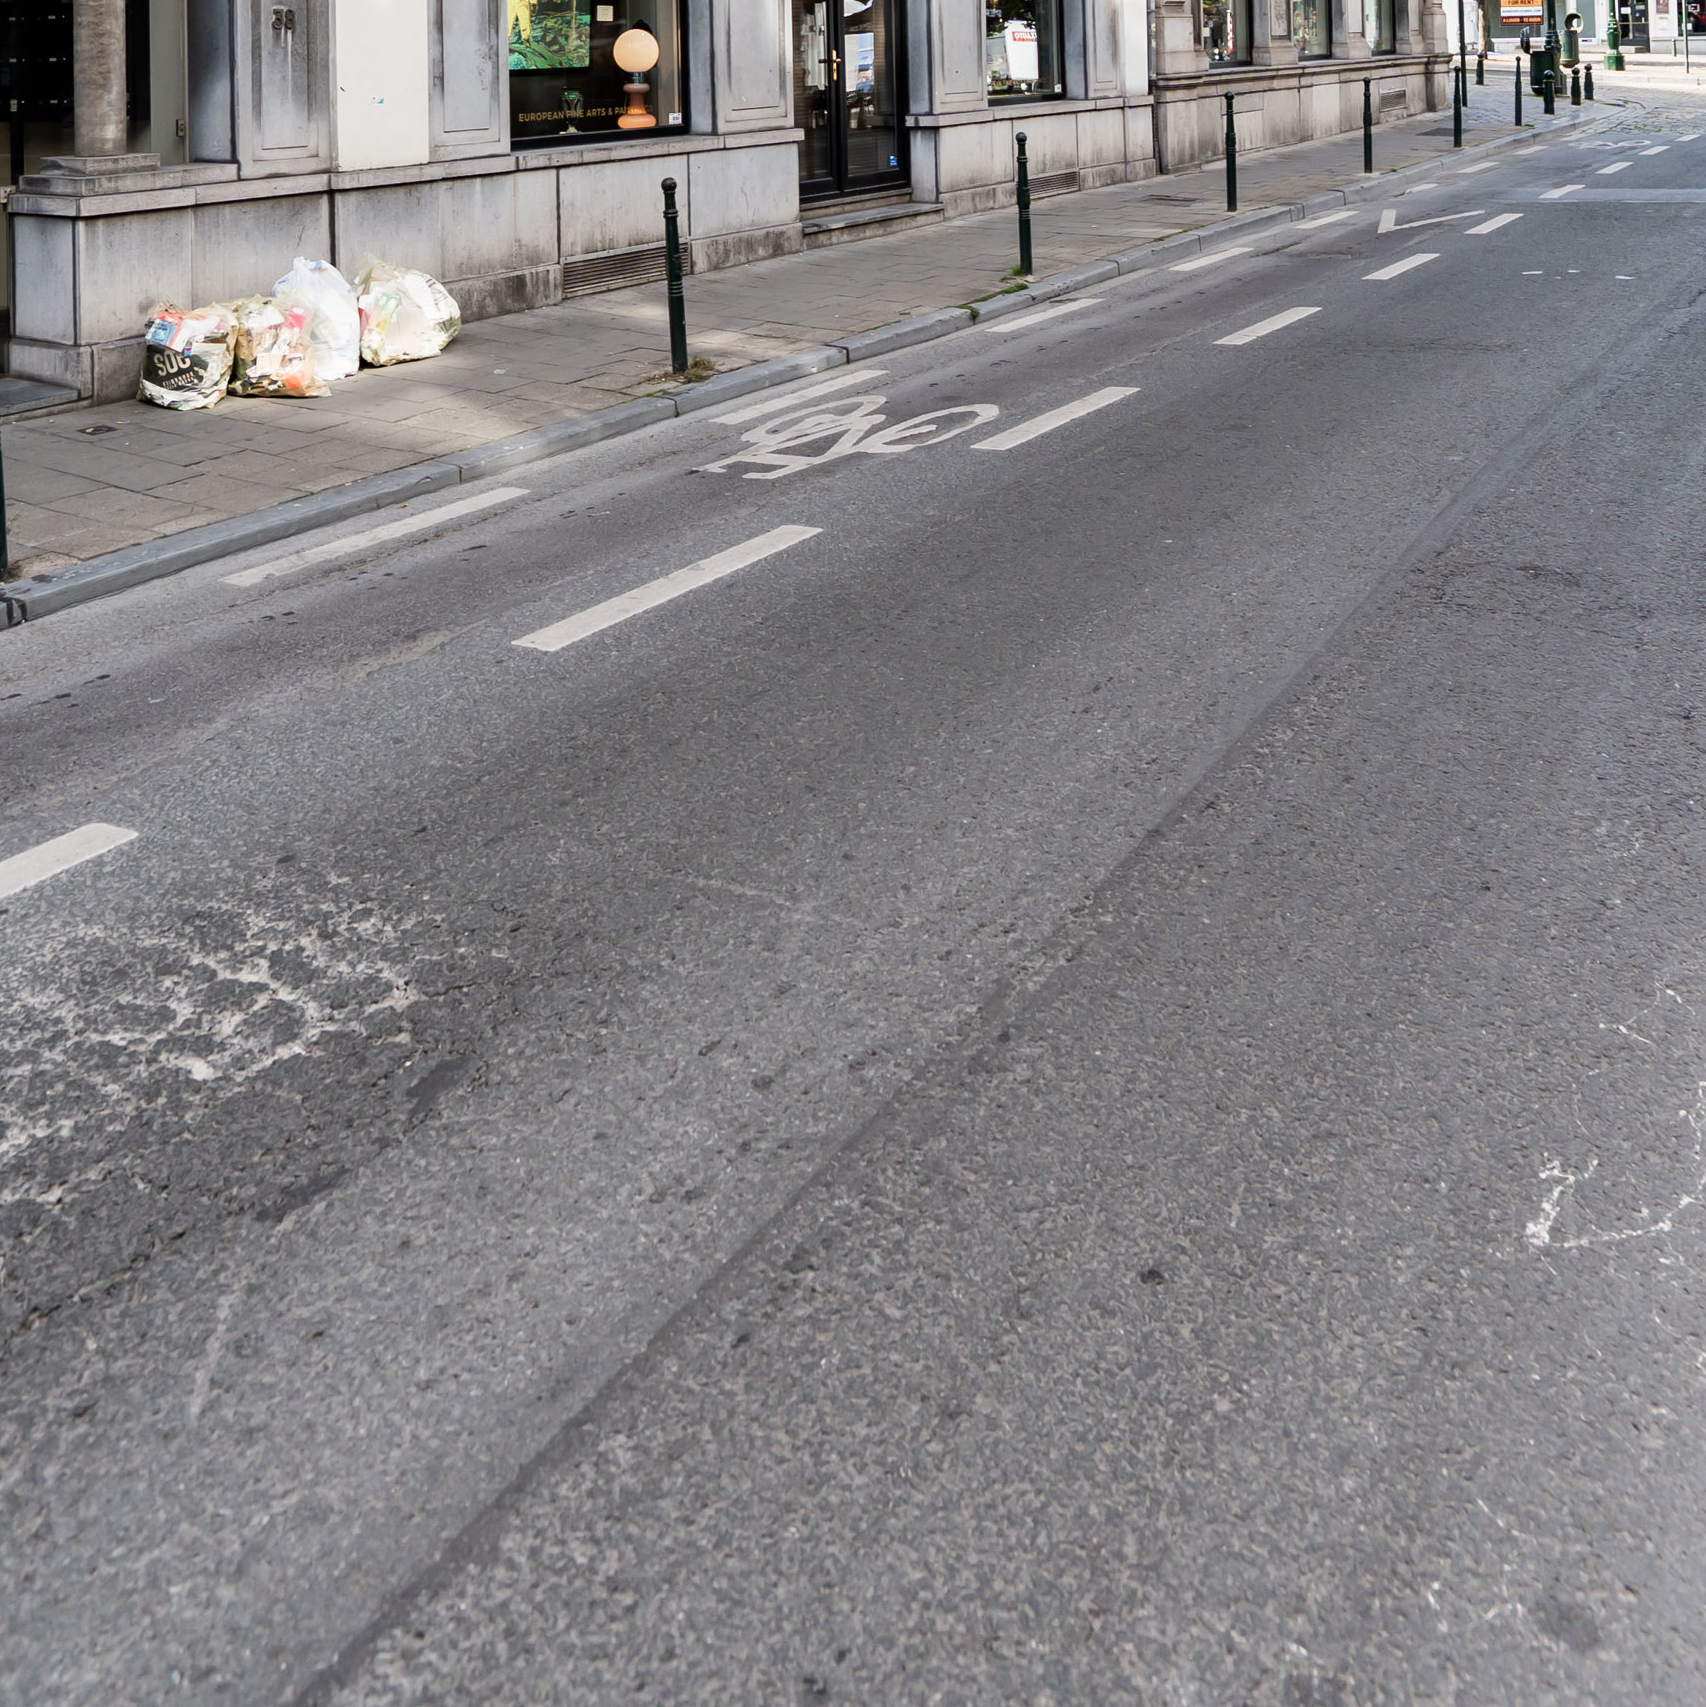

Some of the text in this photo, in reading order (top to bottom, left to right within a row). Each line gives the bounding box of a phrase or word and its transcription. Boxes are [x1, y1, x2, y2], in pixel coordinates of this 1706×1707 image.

[272, 8, 296, 31] 38
[518, 111, 565, 122] EUROPEAN
[566, 109, 584, 119] FINE
[586, 108, 606, 117] ARTS
